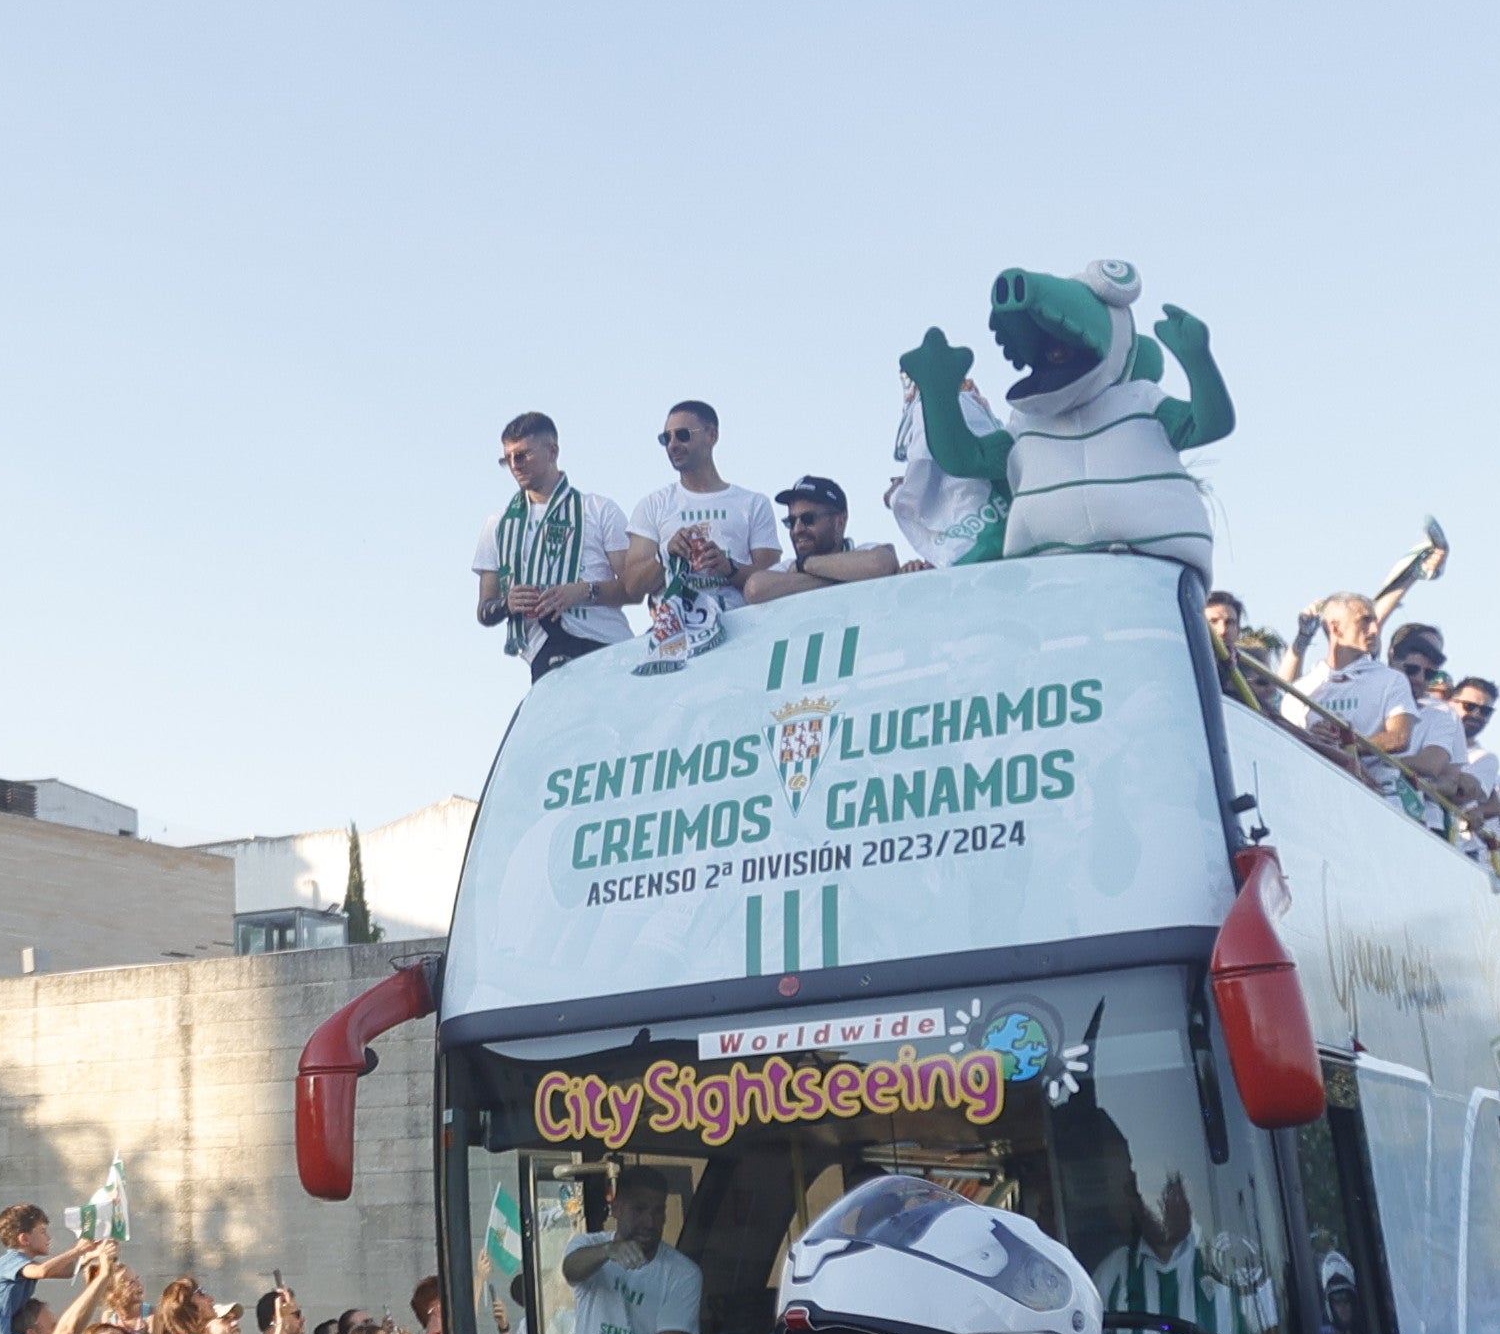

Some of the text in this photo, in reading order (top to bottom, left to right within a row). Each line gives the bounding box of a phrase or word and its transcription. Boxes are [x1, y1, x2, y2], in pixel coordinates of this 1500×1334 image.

[543, 678, 1103, 811] SENTIMOS LUCHAMOS
[571, 748, 1075, 870] CREIMOS GANAMOS
[586, 867, 697, 907] ASCENSO
[741, 840, 851, 885] DIVISIÓN
[861, 820, 1026, 868] 2023/2024
[719, 1013, 936, 1054] Worldwide
[535, 1045, 1005, 1149] City Sightseeing
